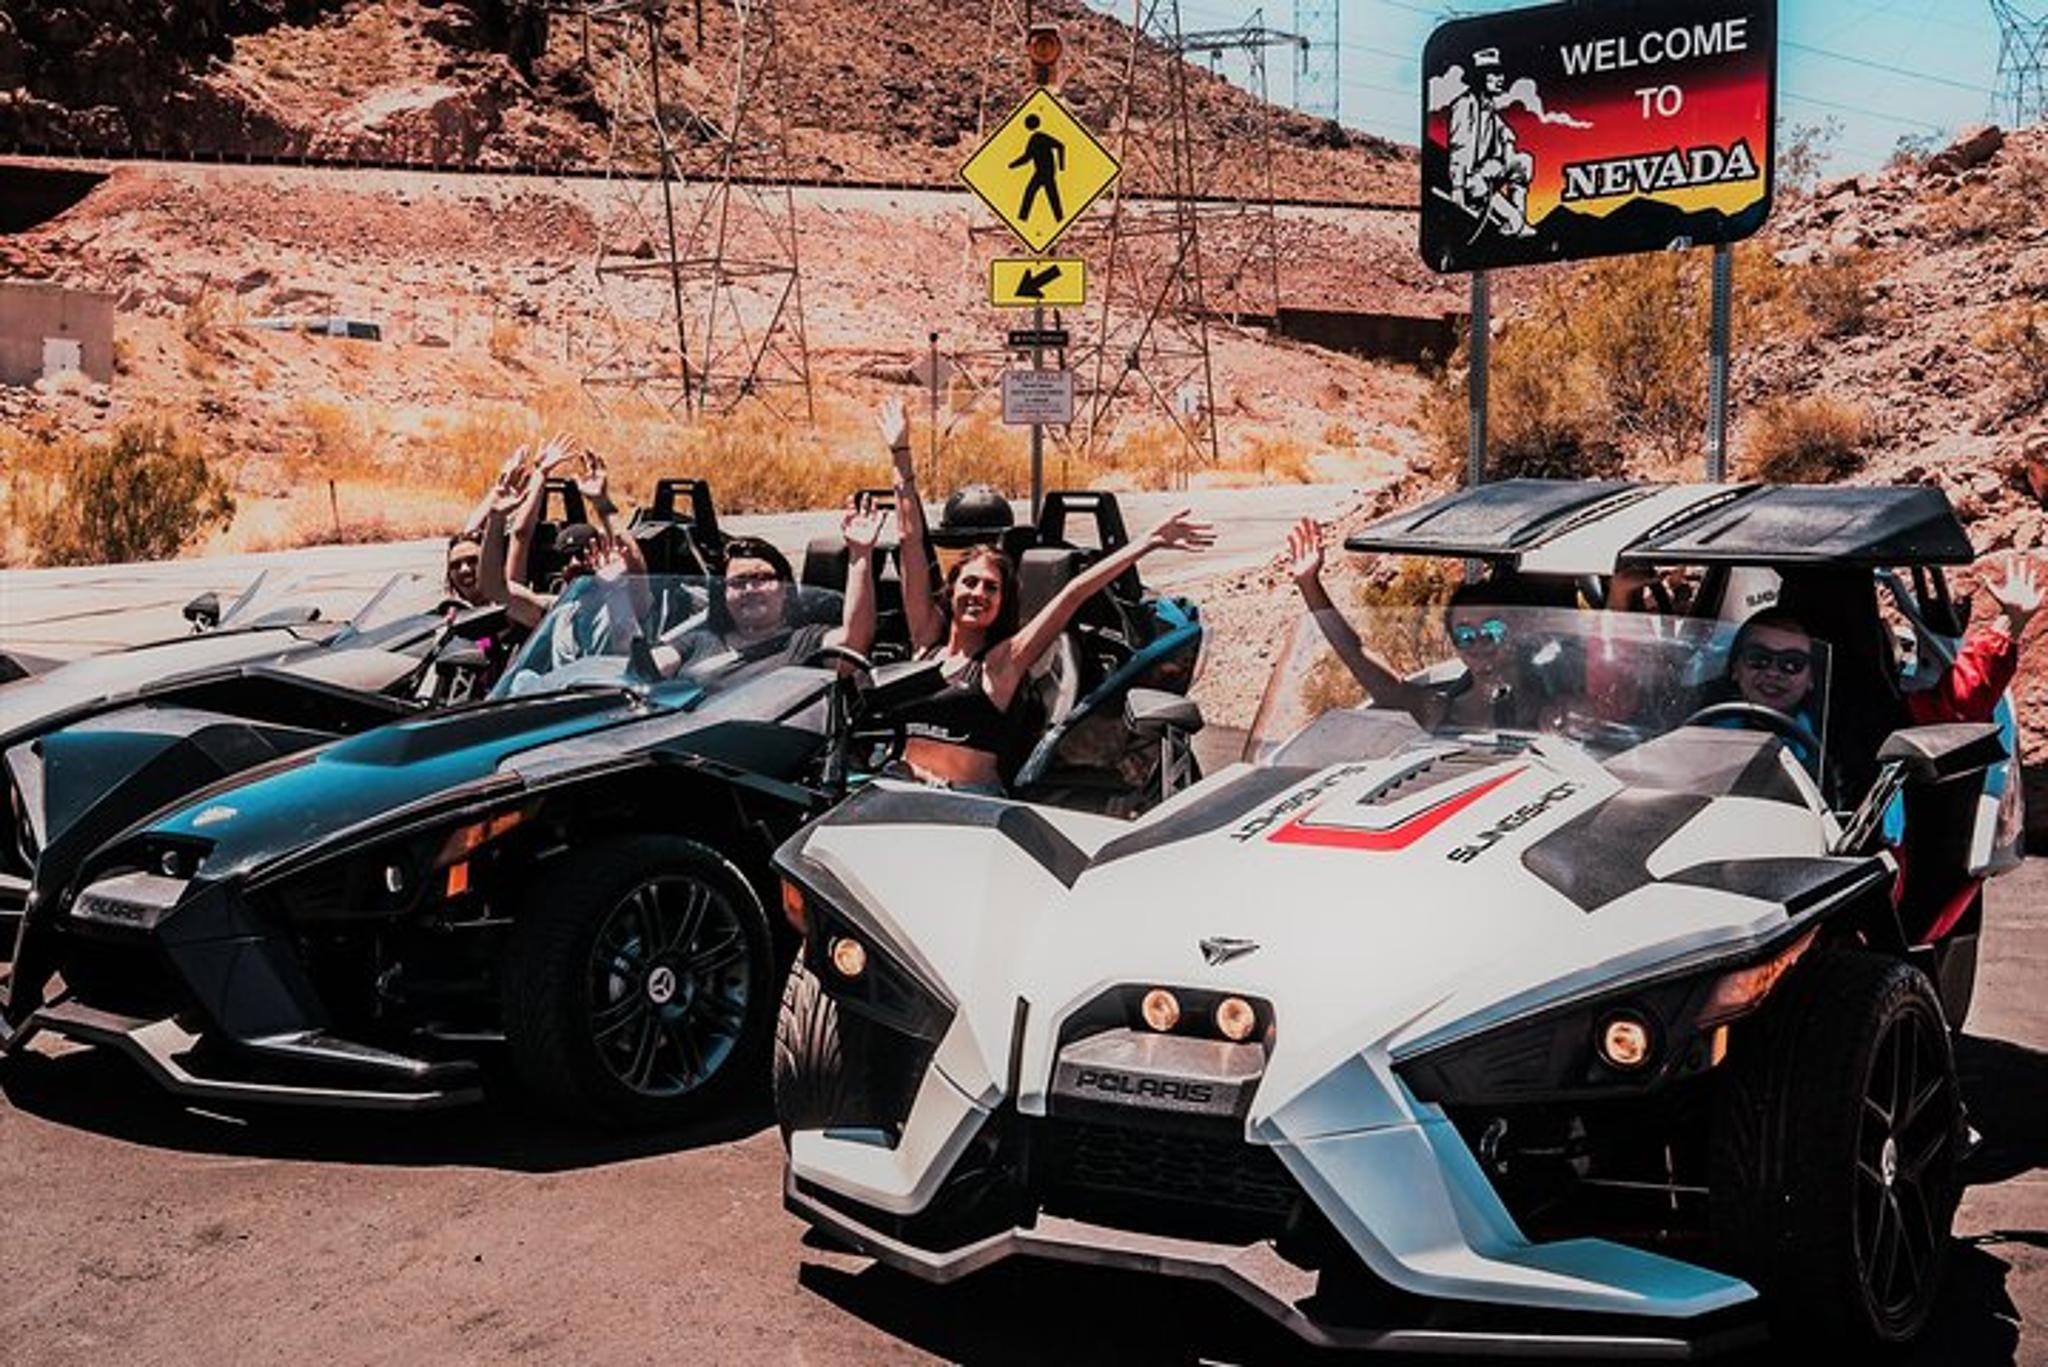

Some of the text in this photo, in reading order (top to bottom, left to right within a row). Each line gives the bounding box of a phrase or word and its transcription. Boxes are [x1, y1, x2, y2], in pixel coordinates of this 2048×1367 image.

[1560, 17, 1749, 76] WELCOME
[1634, 84, 1684, 120] TO
[1563, 141, 1757, 200] NEVADA
[1446, 780, 1576, 863] SLINGSHOT
[1075, 1070, 1214, 1103] POLARIS
